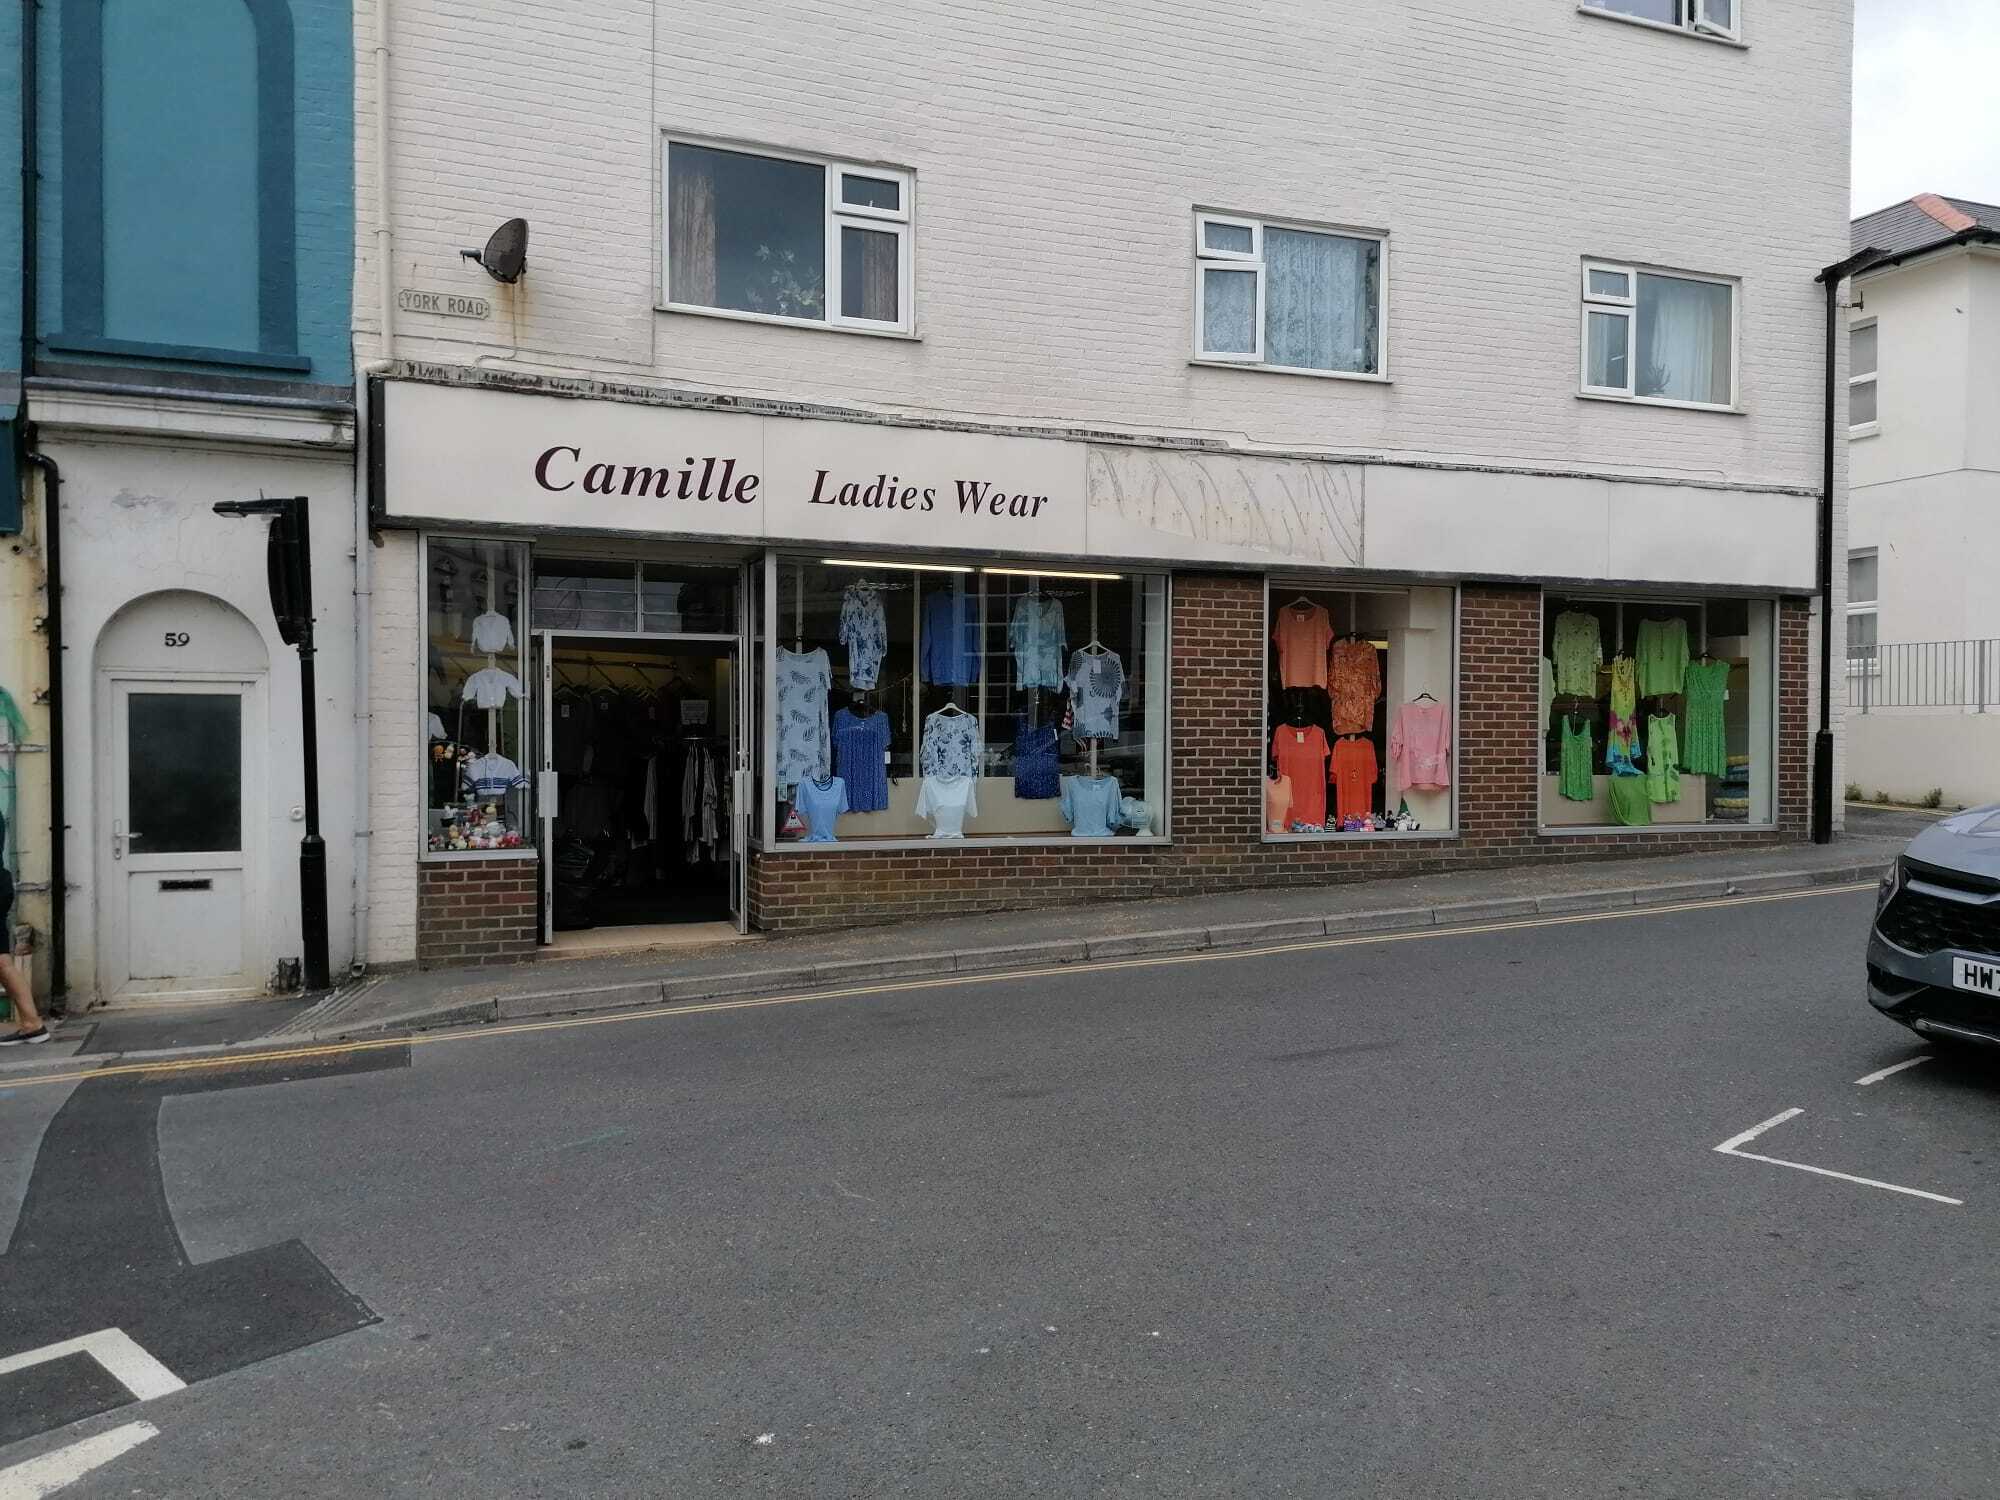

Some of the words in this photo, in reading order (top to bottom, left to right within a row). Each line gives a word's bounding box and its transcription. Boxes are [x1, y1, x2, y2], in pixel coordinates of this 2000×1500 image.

[404, 293, 440, 310] YORK
[448, 298, 484, 316] ROAD
[534, 445, 760, 504] Camille
[807, 469, 938, 513] Ladies
[954, 479, 1049, 518] Wear
[164, 631, 191, 648] 59
